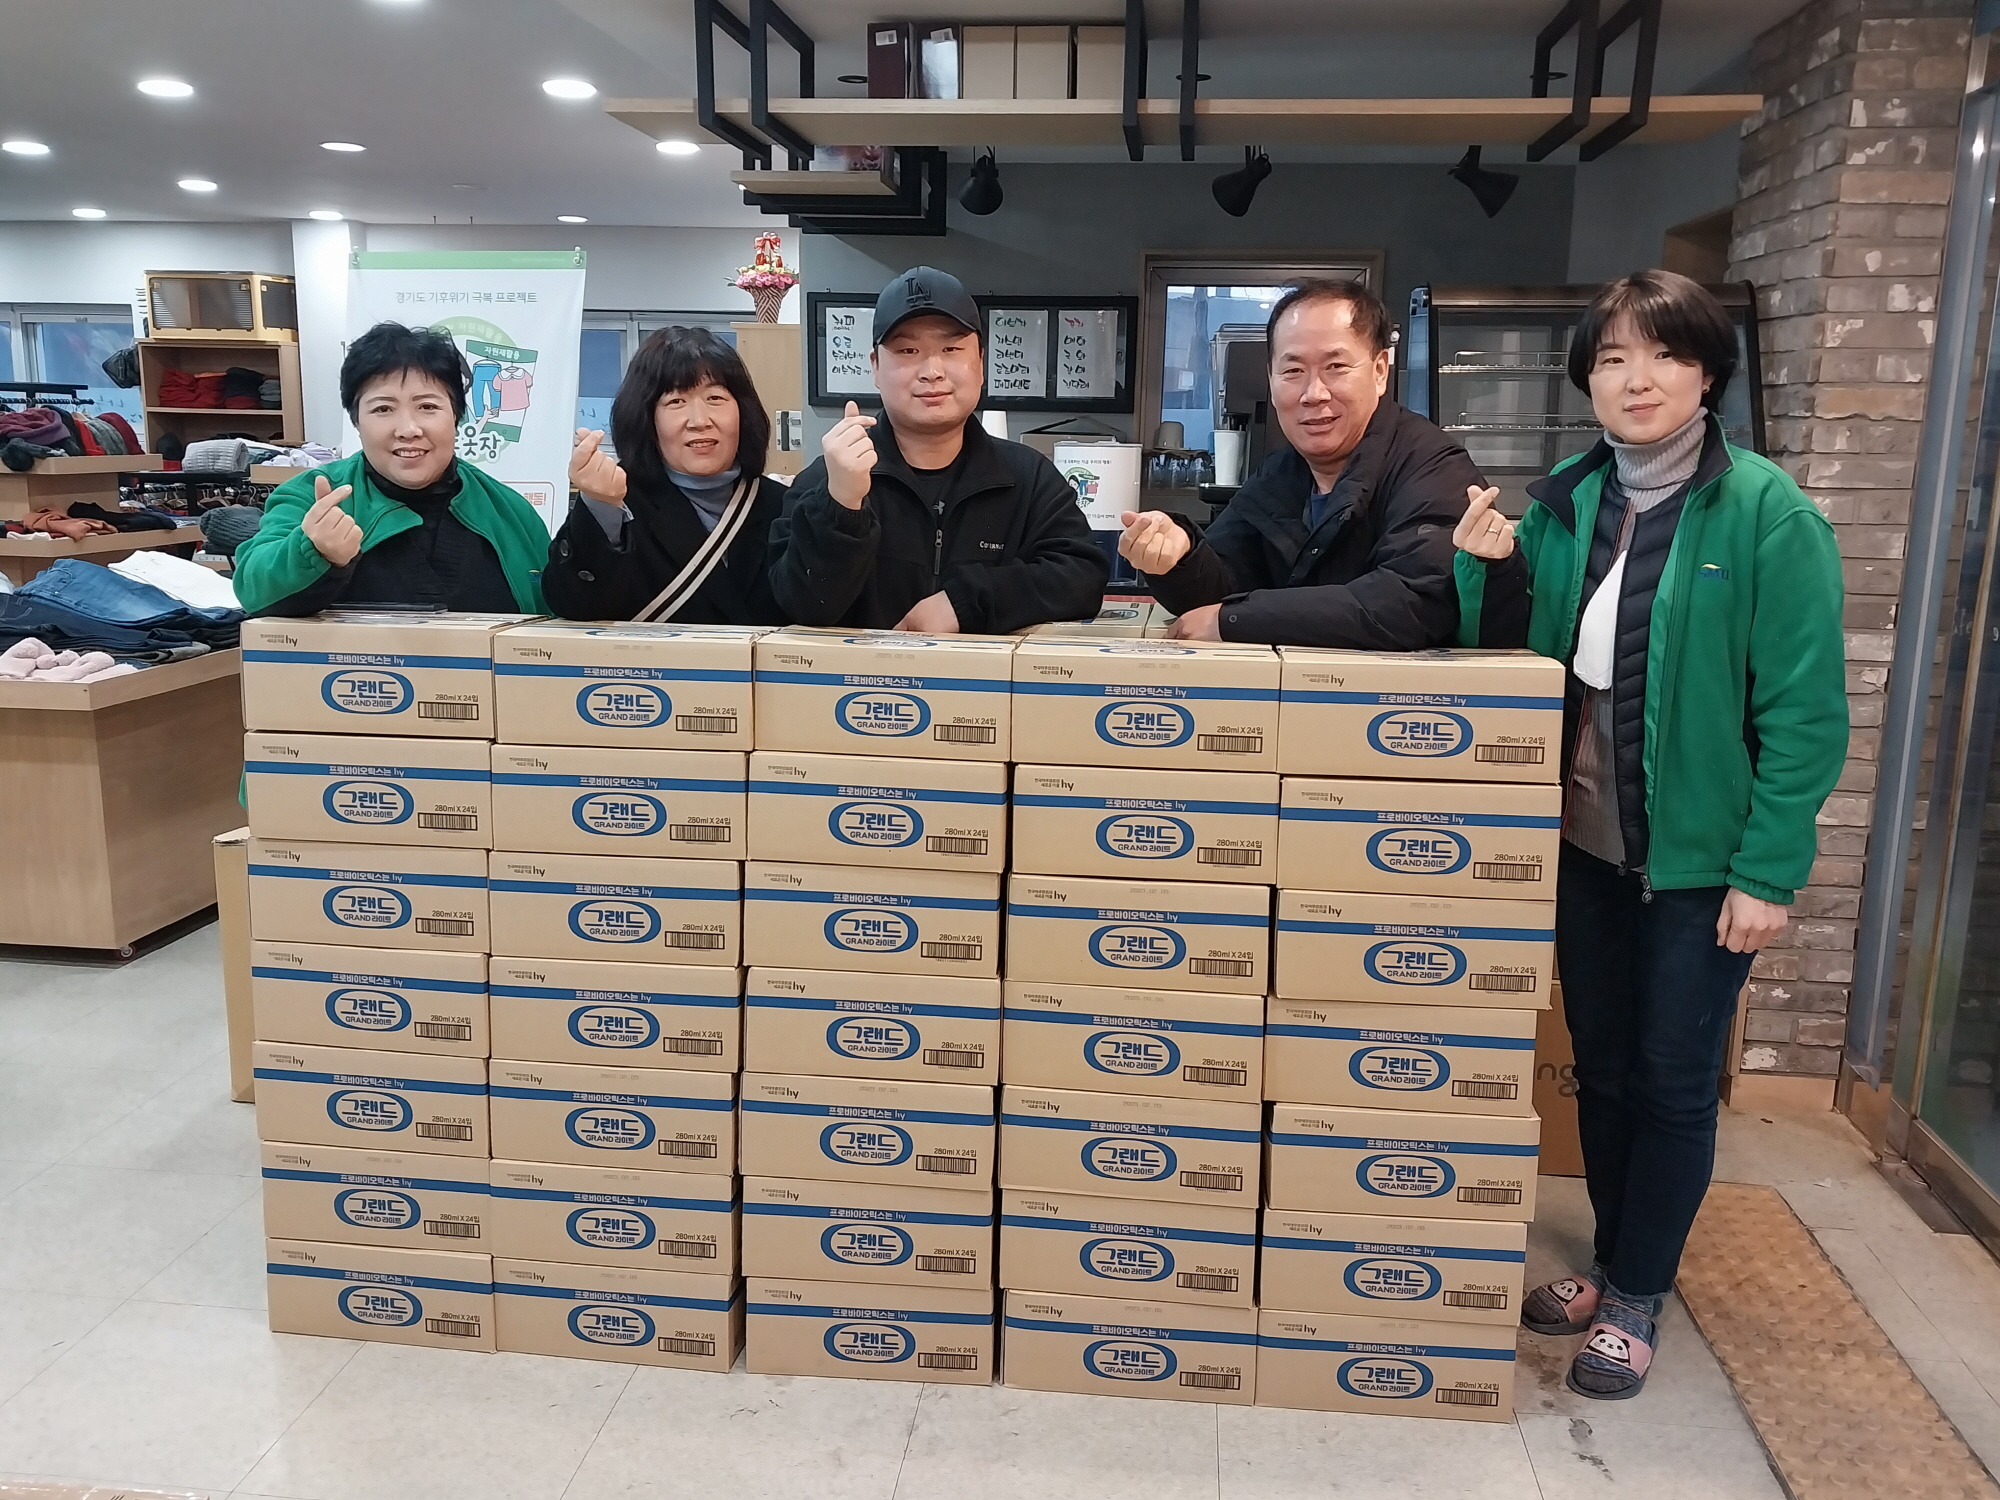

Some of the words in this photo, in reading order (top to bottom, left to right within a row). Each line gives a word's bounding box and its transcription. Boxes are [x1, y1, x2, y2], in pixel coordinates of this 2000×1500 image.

[395, 291, 426, 303] 경기도
[428, 291, 469, 304] 기후위기
[472, 292, 492, 304] 극복
[495, 292, 538, 304] 프로젝트
[832, 314, 855, 326] 커피
[484, 346, 520, 360] 자원재활용
[285, 636, 298, 646] hy
[328, 654, 391, 665] 프로바이오틱스는
[394, 656, 405, 666] hy
[1060, 667, 1074, 678] hy
[336, 680, 397, 699] 그랜드
[463, 694, 479, 702] 24입
[1104, 686, 1172, 697] 프로바이오틱스는
[1175, 687, 1187, 698] hy
[592, 693, 655, 712] 그랜드
[1379, 694, 1451, 705] 프로바이오틱스는
[1454, 695, 1467, 706] hy
[721, 707, 738, 716] 24입
[851, 701, 914, 721] 그랜드
[1112, 712, 1177, 731] 그랜드
[1246, 727, 1264, 735] 24입
[1385, 721, 1454, 741] 그랜드
[794, 767, 807, 778] hy
[580, 777, 644, 787] 프로바이오틱스는
[647, 779, 658, 789] hy
[338, 790, 398, 809] 그랜드
[588, 802, 650, 821] 그랜드
[1377, 812, 1449, 824] 프로바이오틱스는
[1452, 814, 1464, 825] hy
[845, 812, 907, 832] 그랜드
[1112, 824, 1177, 844] 그랜드
[1384, 838, 1453, 858] 그랜드
[338, 895, 396, 914] 그랜드
[834, 893, 898, 905] 프로바이오틱스는
[900, 896, 912, 906] hy
[1054, 891, 1067, 902] hy
[458, 911, 474, 919] 24입
[584, 909, 645, 928] 그랜드
[840, 918, 902, 938] 그랜드
[1105, 935, 1169, 954] 그랜드
[1382, 951, 1449, 970] 그랜드
[332, 973, 391, 986] 프로바이오틱스는
[392, 977, 403, 987] hy
[340, 997, 396, 1018] 그랜드
[1313, 1011, 1327, 1022] hy
[584, 1014, 644, 1034] 그랜드
[1093, 1016, 1159, 1028] 프로바이오틱스는
[1161, 1020, 1173, 1030] hy
[842, 1026, 904, 1045] 그랜드
[1100, 1040, 1163, 1062] 그랜드
[1367, 1055, 1432, 1076] 그랜드
[341, 1098, 397, 1118] 그랜드
[573, 1092, 634, 1104] 프로바이오틱스는
[637, 1096, 648, 1105] hy
[580, 1116, 639, 1136] 그랜드
[836, 1131, 897, 1151] 그랜드
[1367, 1140, 1434, 1151] 프로바이오틱스는
[1437, 1142, 1449, 1152] hy
[299, 1157, 311, 1167] hy
[961, 1149, 977, 1157] 24입
[1098, 1146, 1160, 1167] 그랜드
[1103, 1165, 1132, 1174] GRAND
[1133, 1167, 1154, 1176] 라이트
[1373, 1164, 1438, 1183] 그랜드
[348, 1197, 405, 1216] 그랜드
[830, 1209, 893, 1220] 프로바이오틱스는
[895, 1212, 906, 1222] hy
[1046, 1203, 1059, 1214] hy
[582, 1216, 640, 1236] 그랜드
[837, 1232, 897, 1251] 그랜드
[1096, 1247, 1158, 1268] 그랜드
[344, 1271, 402, 1284] 프로바이오틱스는
[404, 1276, 414, 1286] hy
[533, 1272, 545, 1282] hy
[1361, 1267, 1424, 1287] 그랜드
[352, 1294, 407, 1314] 그랜드
[582, 1313, 639, 1332] 그랜드
[1092, 1325, 1156, 1337] 프로바이오틱스는
[1158, 1329, 1170, 1338] hy
[1304, 1325, 1317, 1335] hy
[839, 1331, 899, 1349] 그랜드
[1099, 1348, 1161, 1368] 그랜드
[1354, 1366, 1416, 1385] 그랜드
